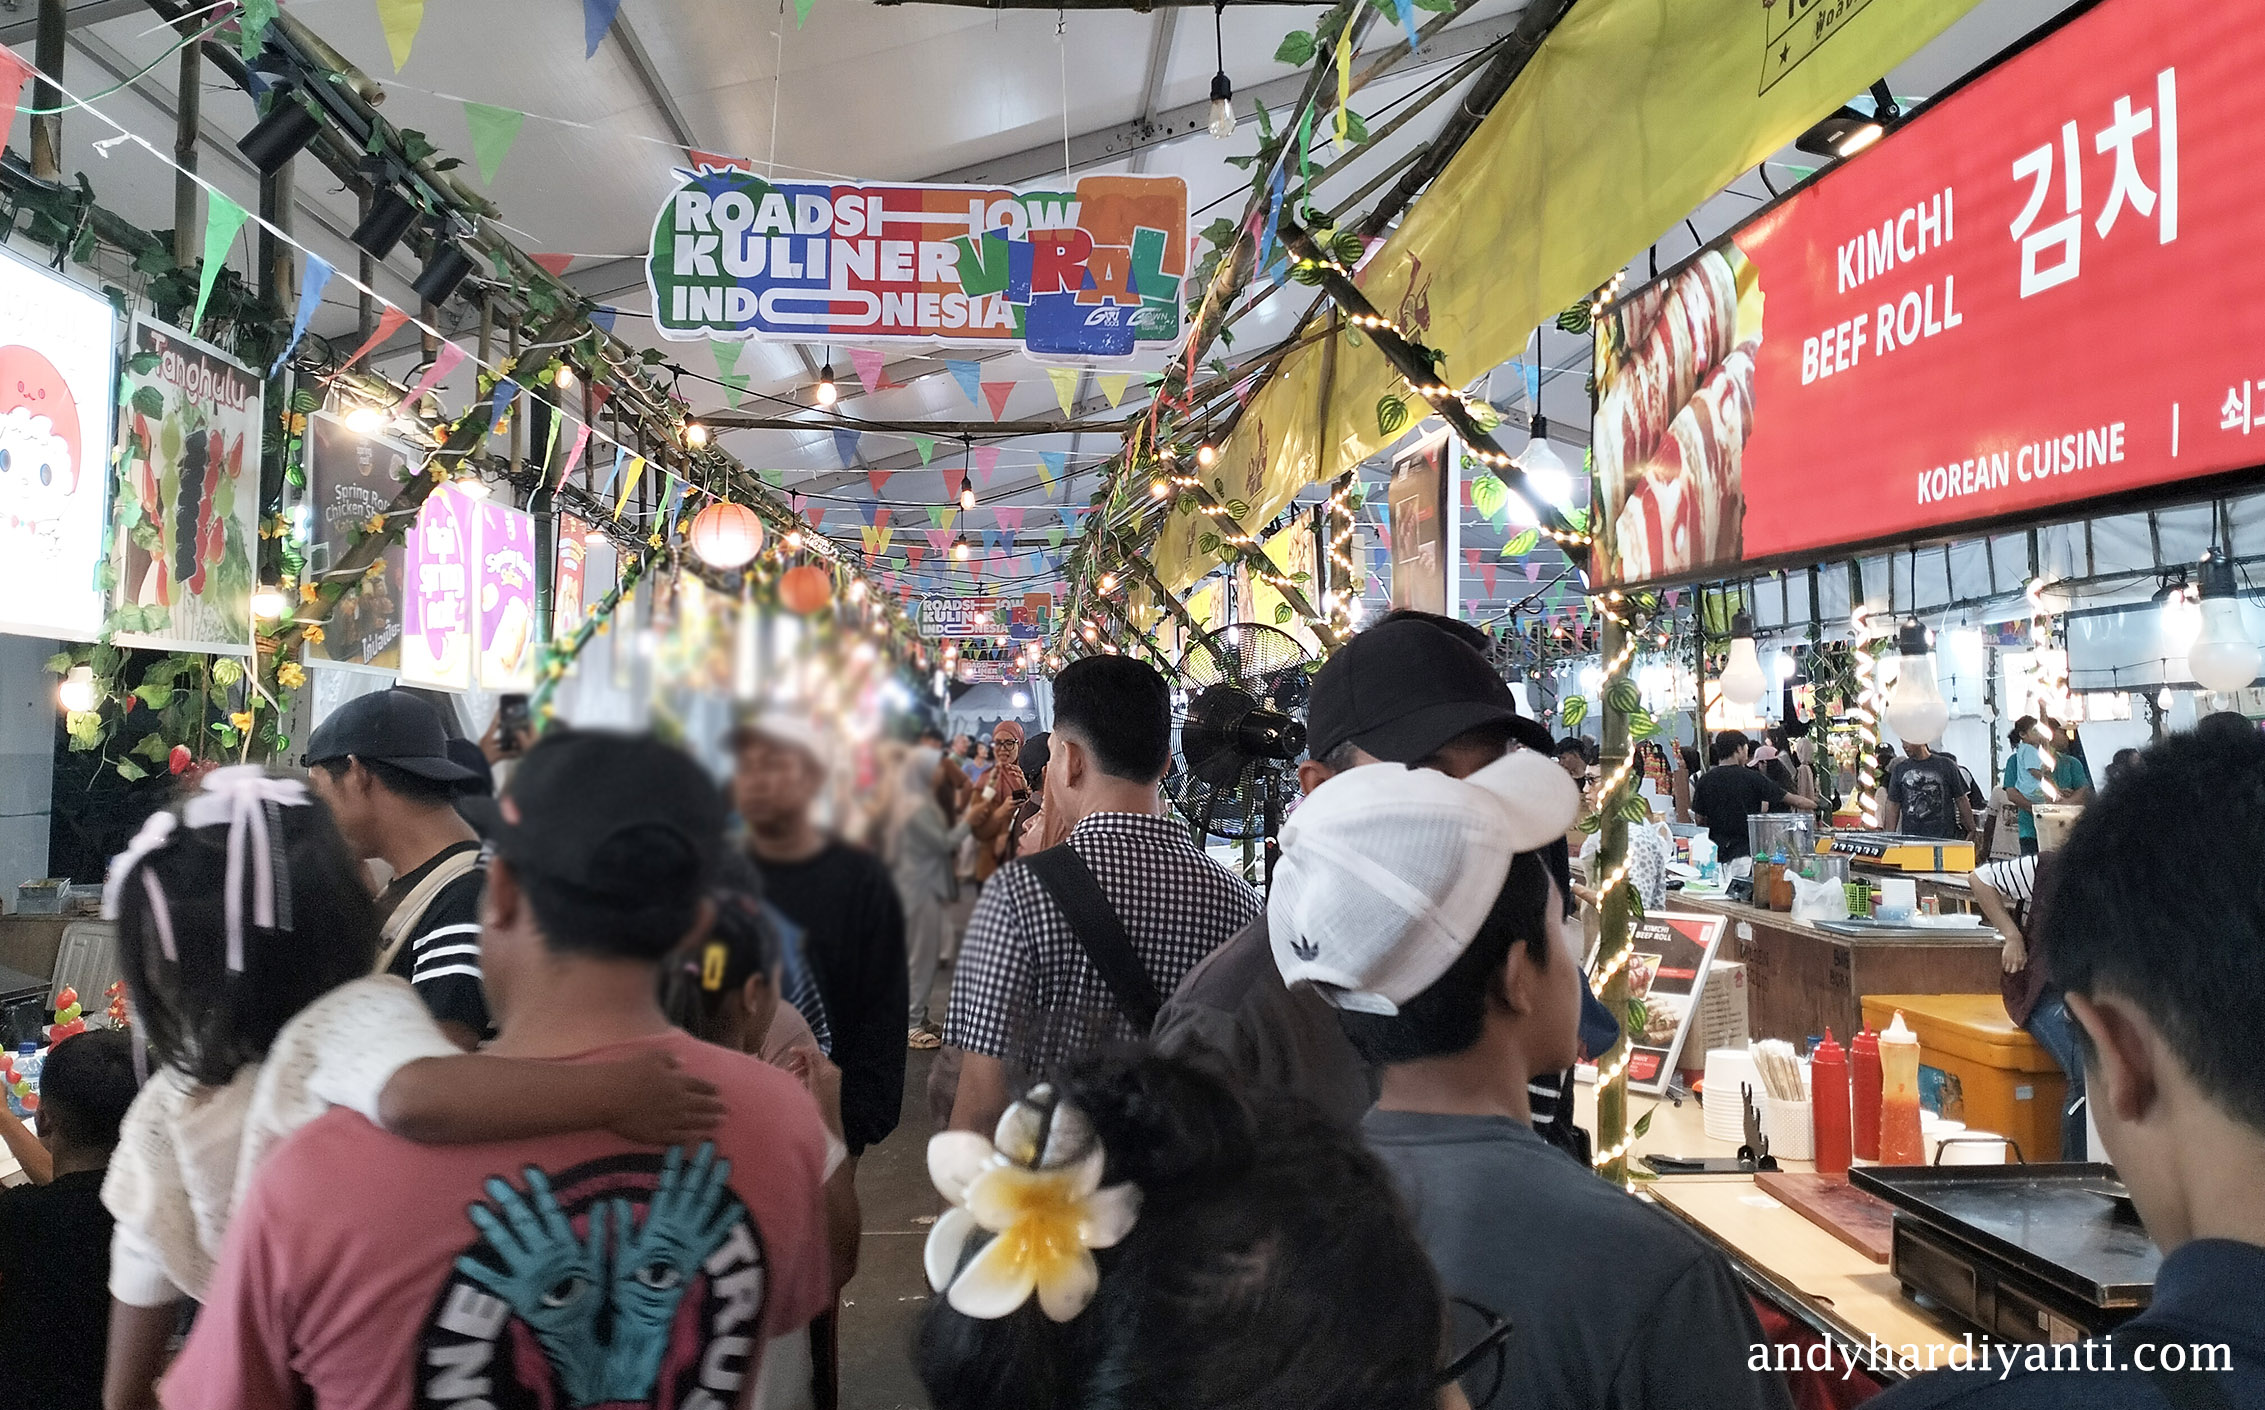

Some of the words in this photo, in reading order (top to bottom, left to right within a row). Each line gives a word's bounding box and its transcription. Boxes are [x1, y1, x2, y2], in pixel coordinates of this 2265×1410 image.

[675, 190, 1083, 240] ROADSHOW
[2009, 66, 2178, 298] 김치
[673, 234, 962, 291] KULINER
[942, 225, 1184, 307] VIRAL
[1838, 187, 1954, 294] KIMCHI
[672, 285, 1018, 329] INDONESIA
[1802, 313, 1868, 386] BEEF
[1876, 275, 1963, 357] ROLL
[150, 330, 246, 413] Tanghulu
[335, 482, 369, 506] Spring
[1918, 451, 2010, 505] KOREAN
[2017, 422, 2126, 482] CUISINE
[325, 499, 364, 522] Chicken
[921, 611, 997, 625] KULINR
